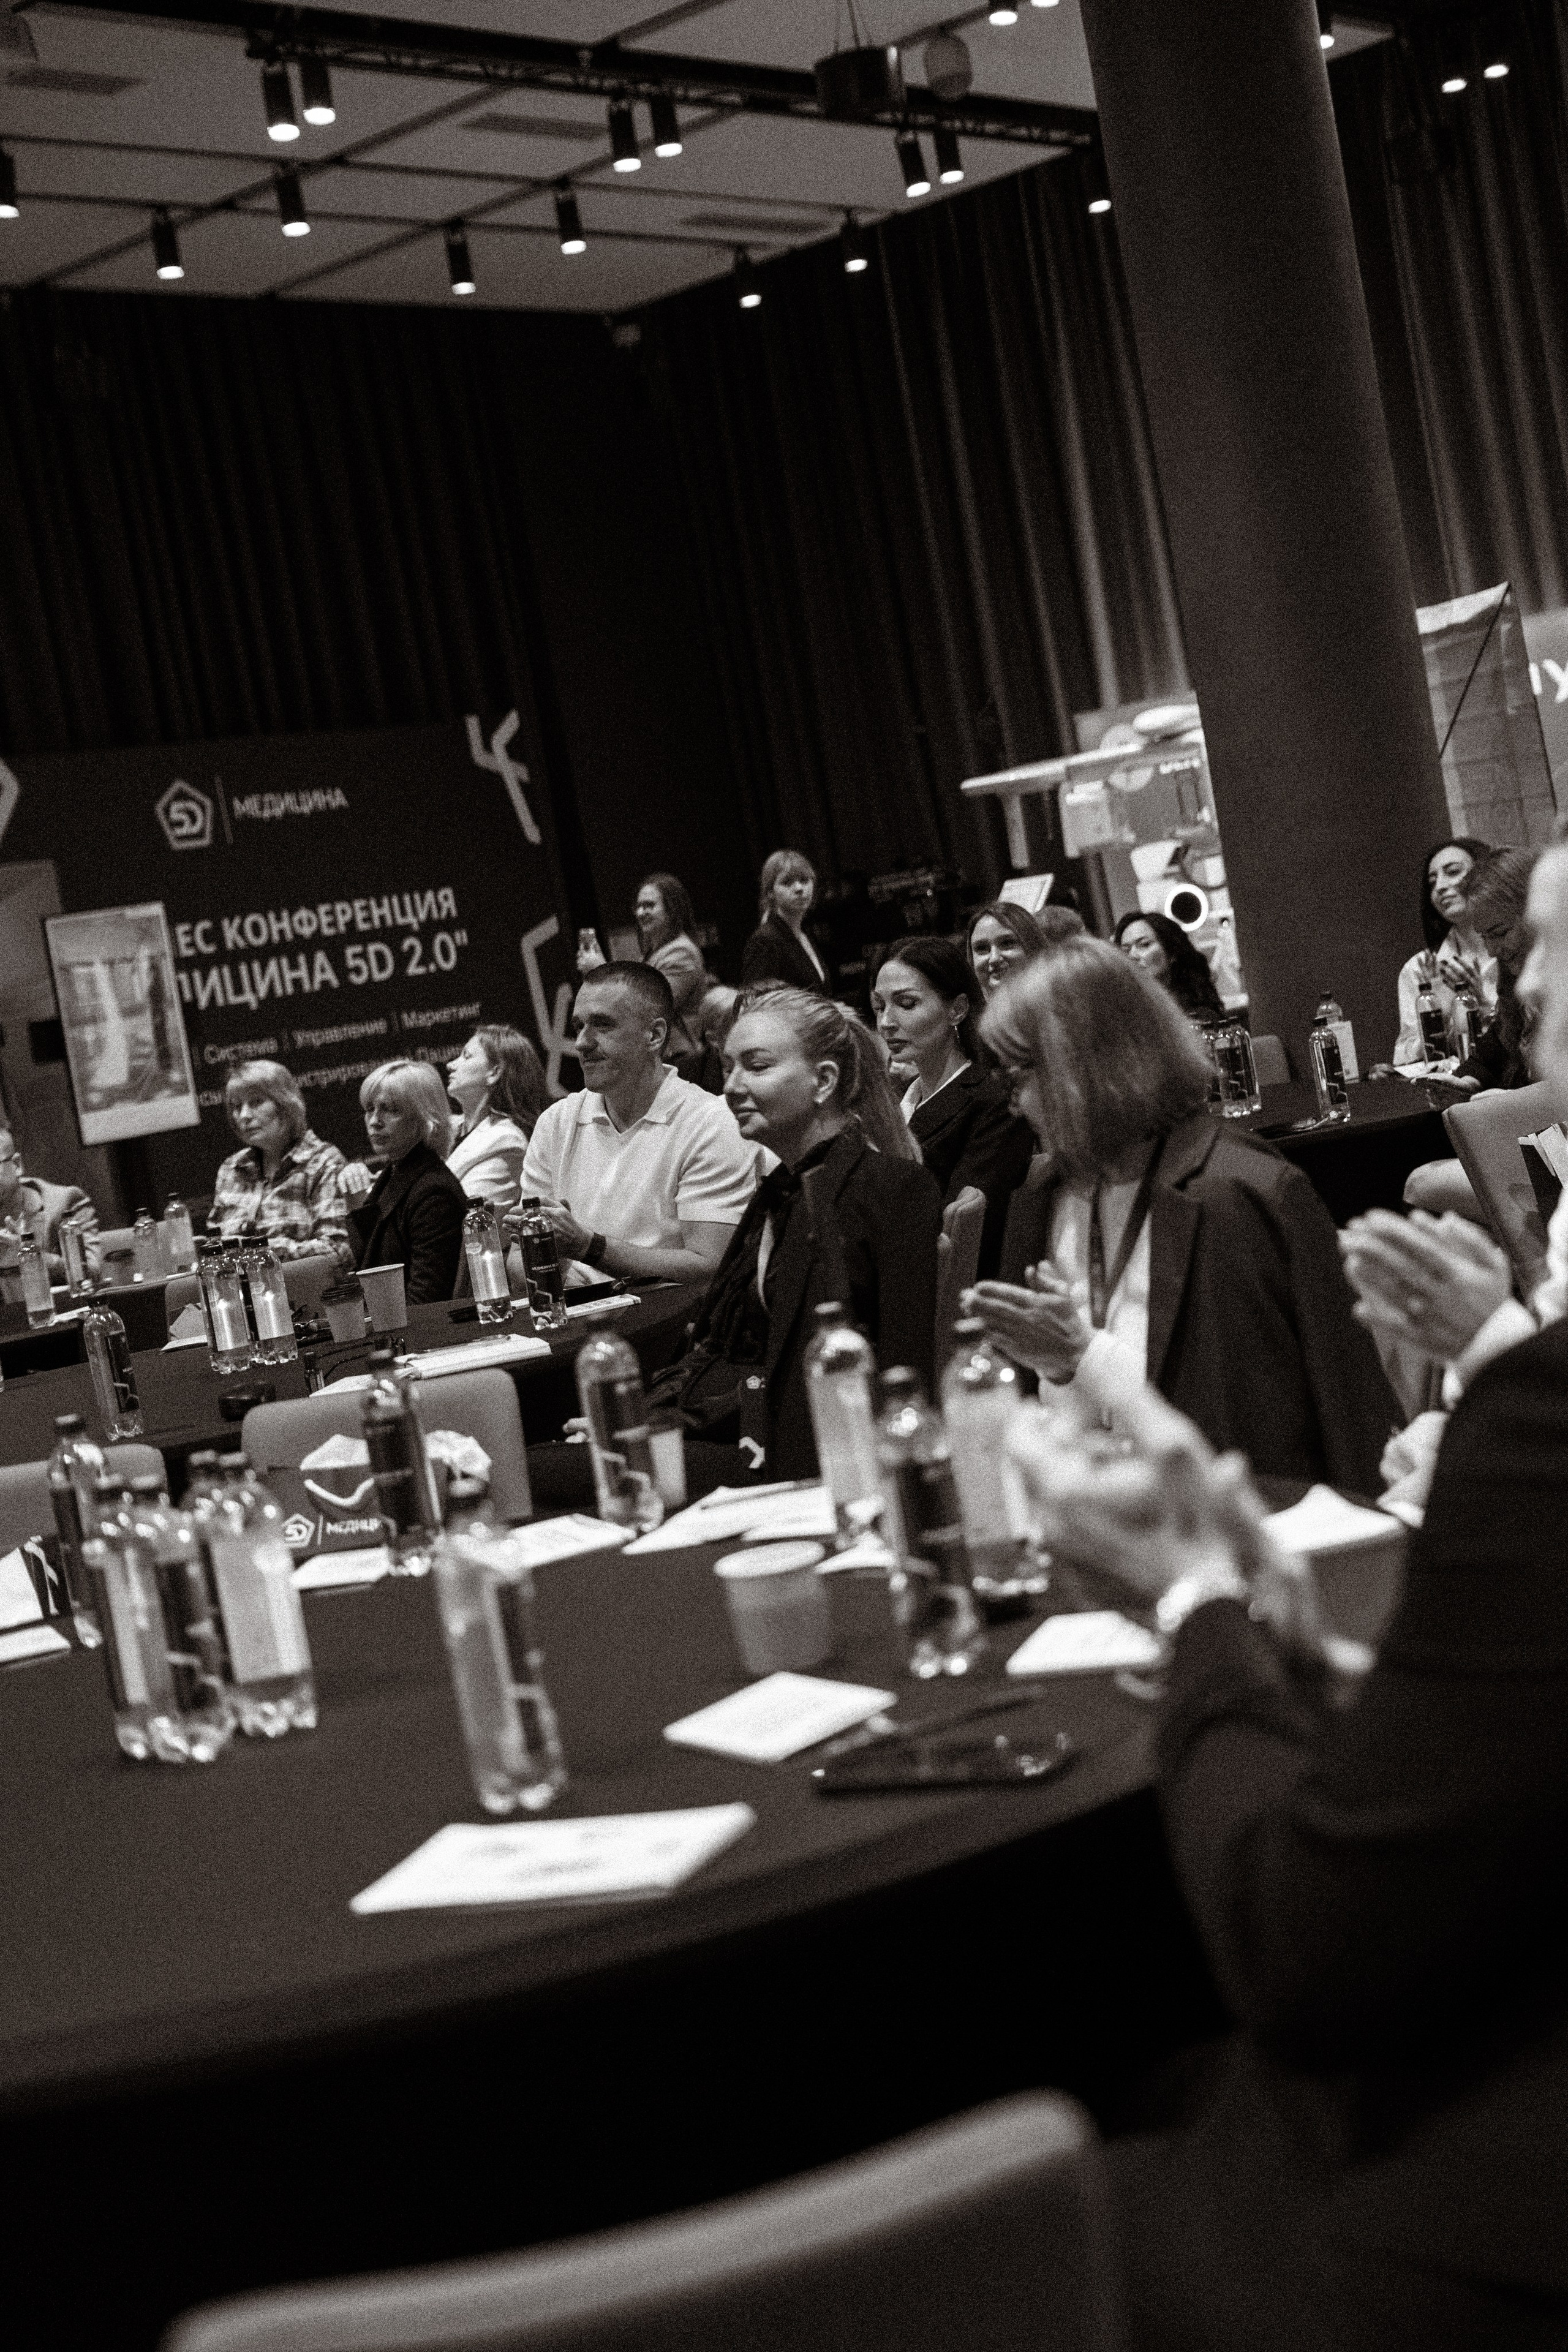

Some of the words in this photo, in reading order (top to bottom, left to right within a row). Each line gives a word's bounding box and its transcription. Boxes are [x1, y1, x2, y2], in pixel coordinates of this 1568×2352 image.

[232, 787, 350, 820] МЕДИЦИНА
[221, 887, 458, 951] КОНФЕРЕНЦИЯ
[344, 941, 395, 984] 5D
[401, 929, 469, 976] 2.0"
[203, 1036, 278, 1065] Система
[292, 1017, 388, 1049] Управление
[401, 1001, 481, 1028] Маркетинг
